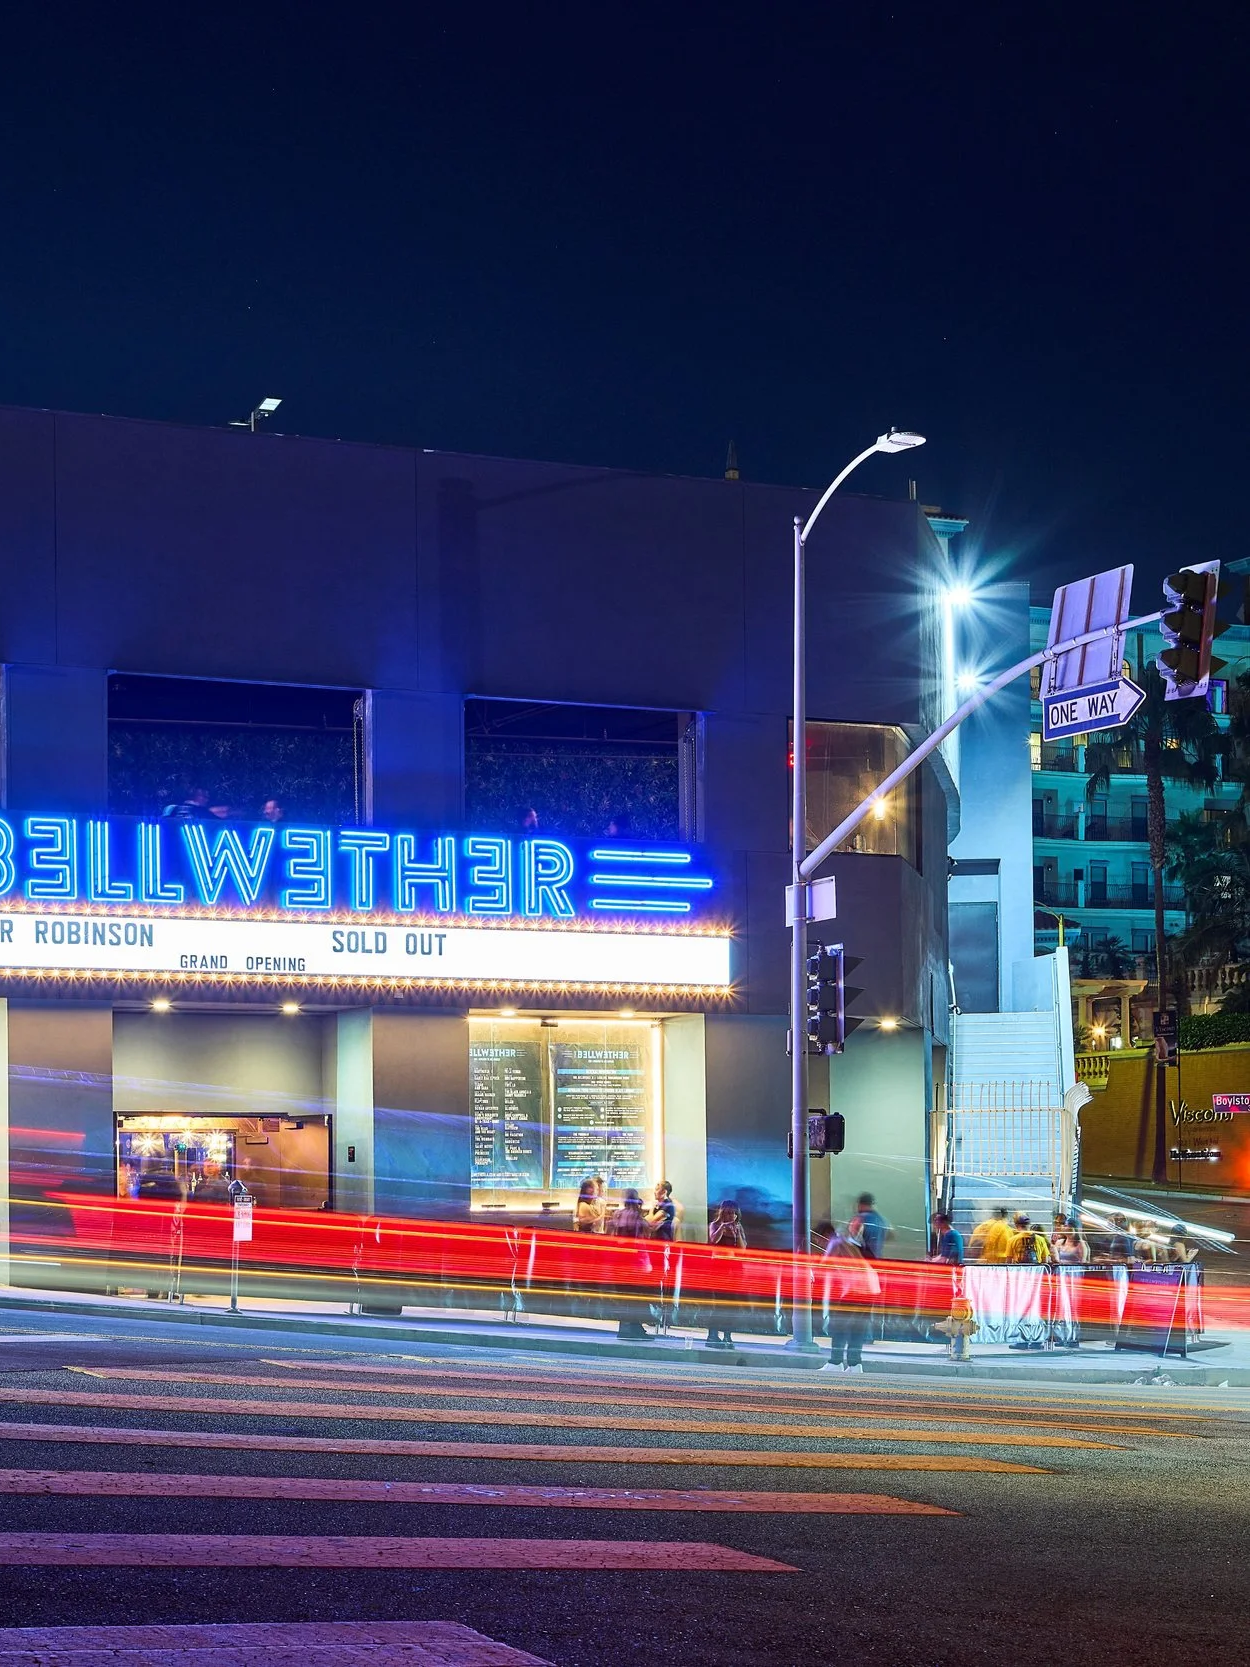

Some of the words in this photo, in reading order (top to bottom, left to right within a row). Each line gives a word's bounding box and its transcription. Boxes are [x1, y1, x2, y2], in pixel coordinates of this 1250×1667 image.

[1051, 702, 1079, 726] ONE
[1088, 692, 1118, 717] WAY
[35, 920, 154, 948] ROBINSON
[332, 929, 389, 955] SOLD
[405, 932, 448, 957] OUT
[179, 954, 228, 970] GRAND
[246, 956, 307, 972] OPENING
